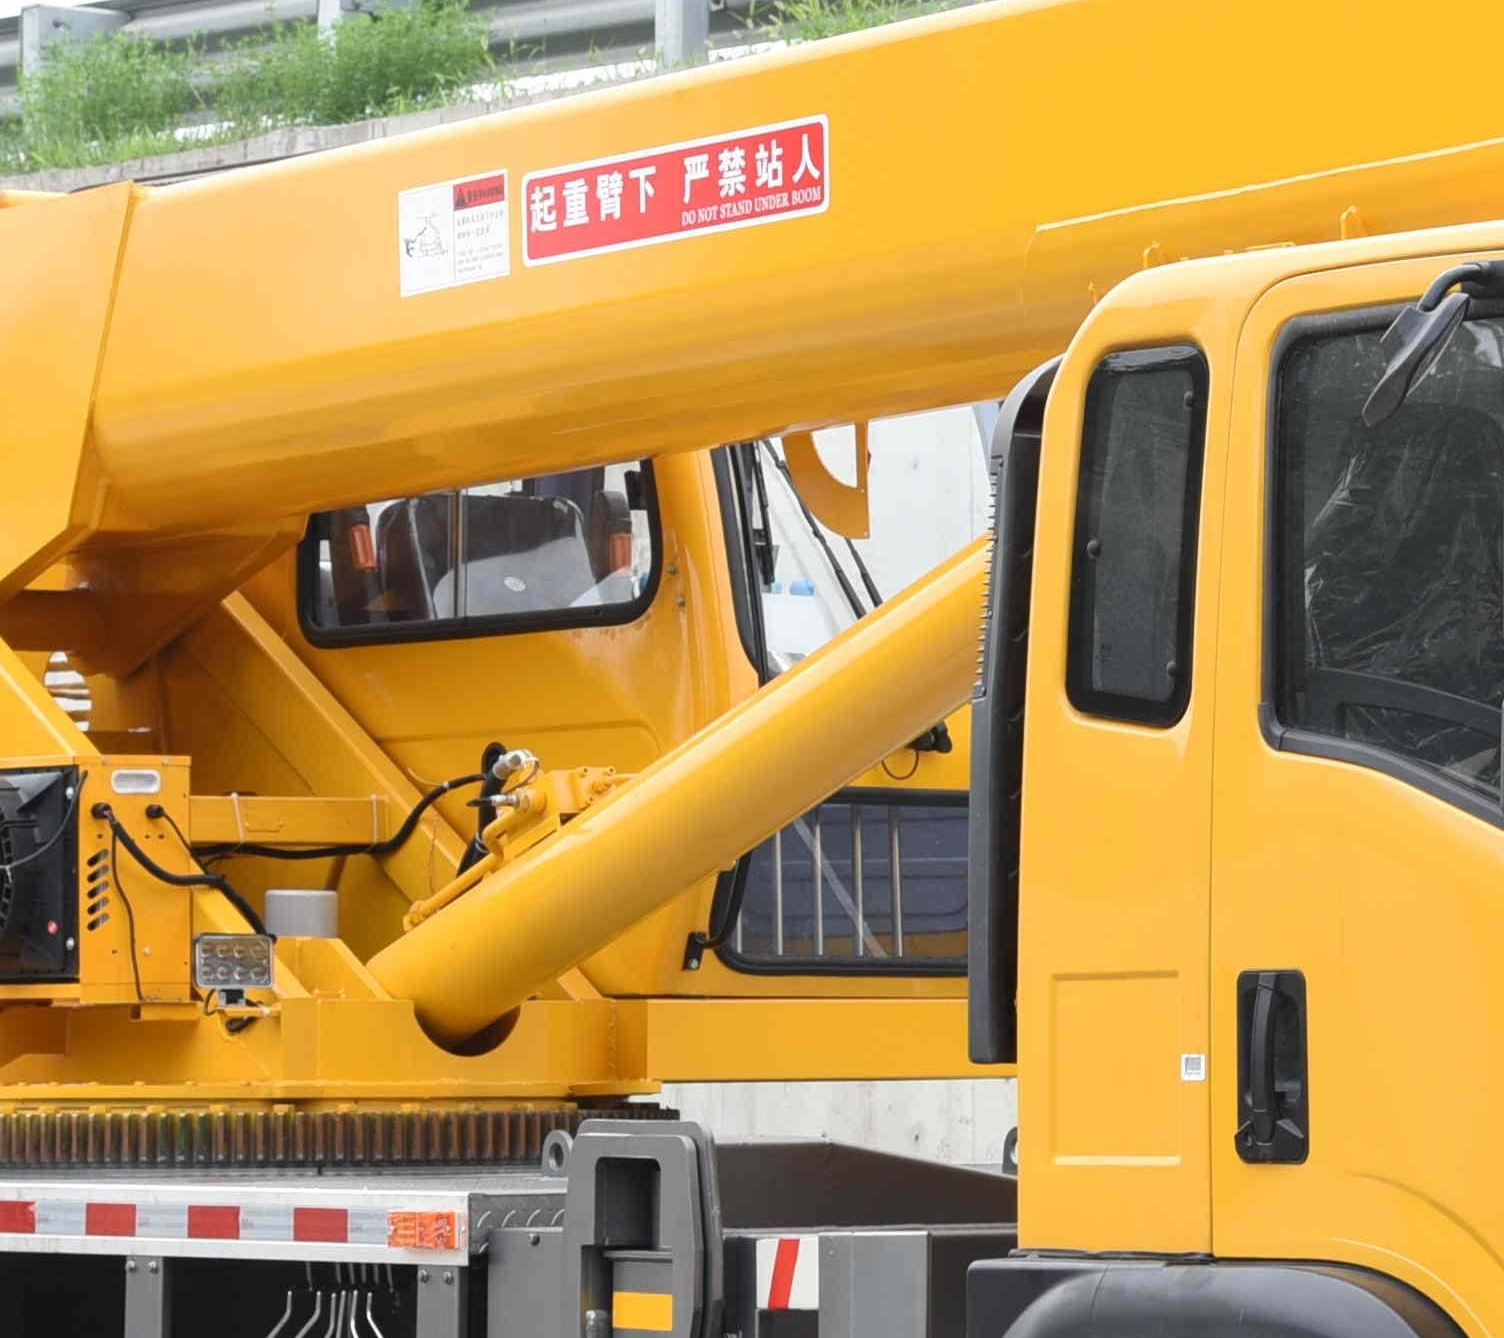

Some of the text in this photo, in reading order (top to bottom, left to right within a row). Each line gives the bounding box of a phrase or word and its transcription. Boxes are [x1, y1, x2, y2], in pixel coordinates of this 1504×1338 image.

[529, 165, 657, 234] 起重臂下
[682, 133, 821, 205] 严禁站人
[681, 186, 822, 226] DO NOT STAND UNDER BOOM
